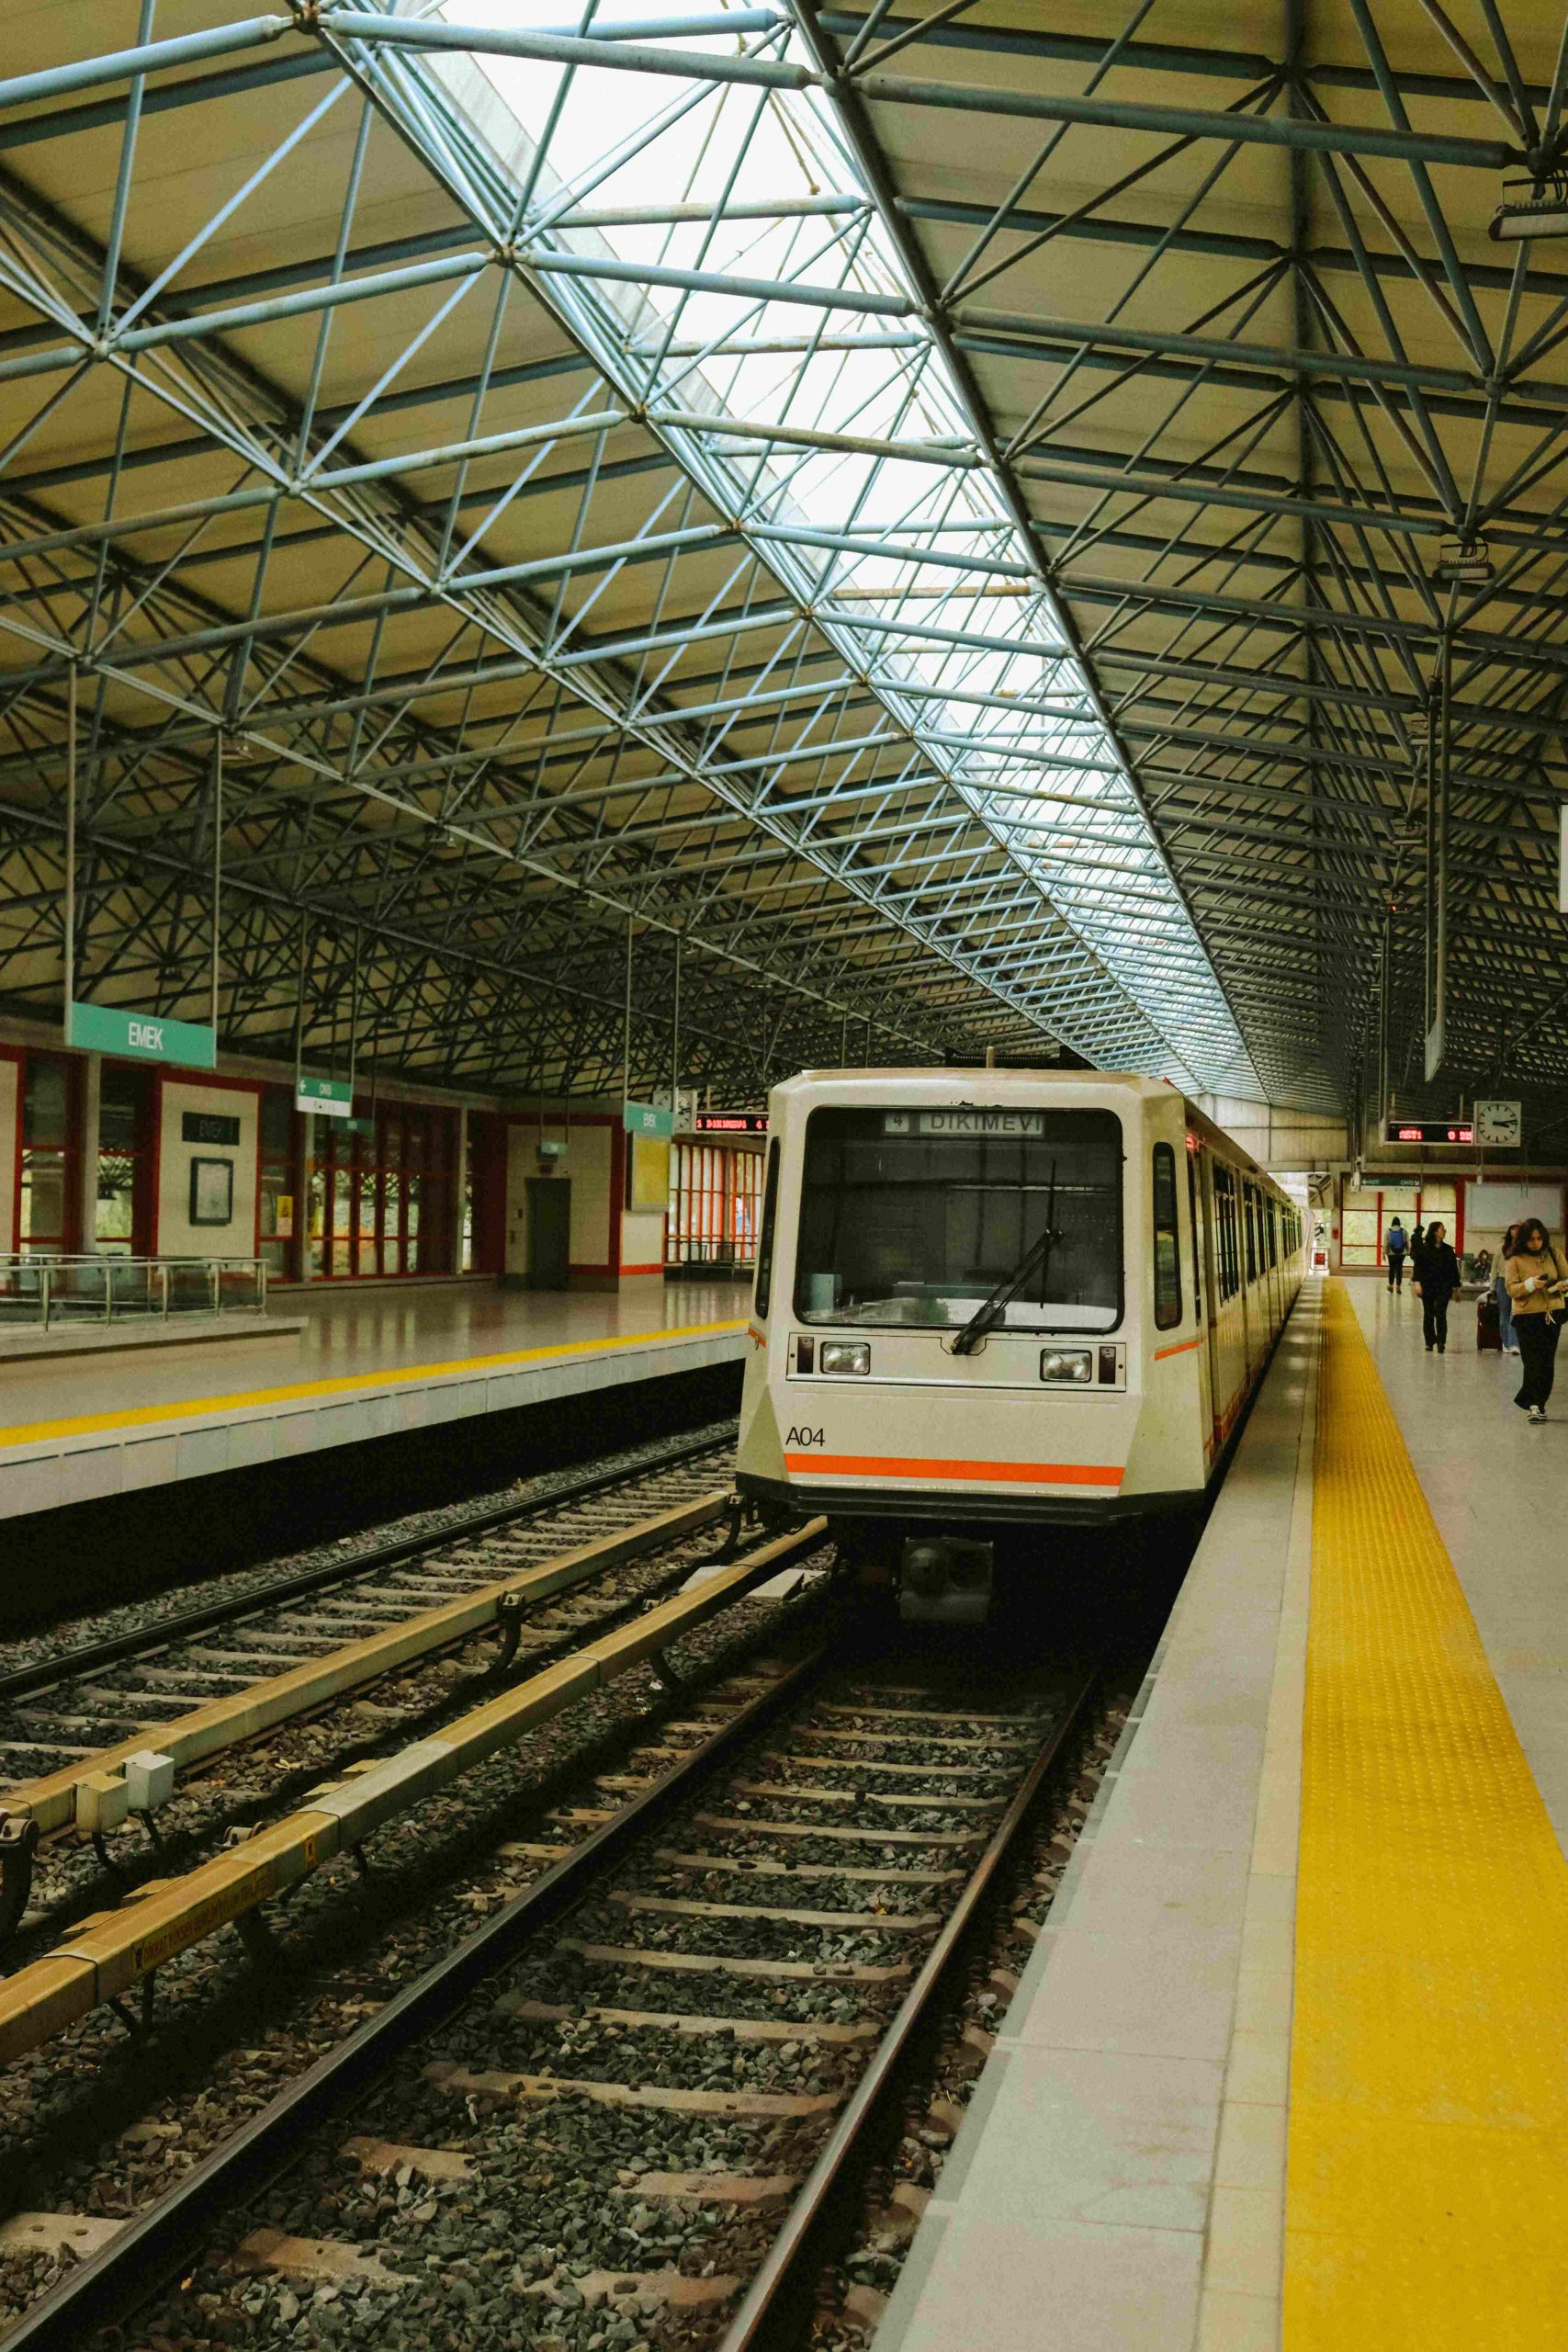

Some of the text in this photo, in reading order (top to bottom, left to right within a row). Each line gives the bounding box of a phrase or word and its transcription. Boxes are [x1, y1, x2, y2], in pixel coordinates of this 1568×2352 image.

[129, 1022, 164, 1050] EMEK
[893, 1114, 1041, 1131] 4 DIKIMEVI
[784, 1427, 826, 1447] A04
